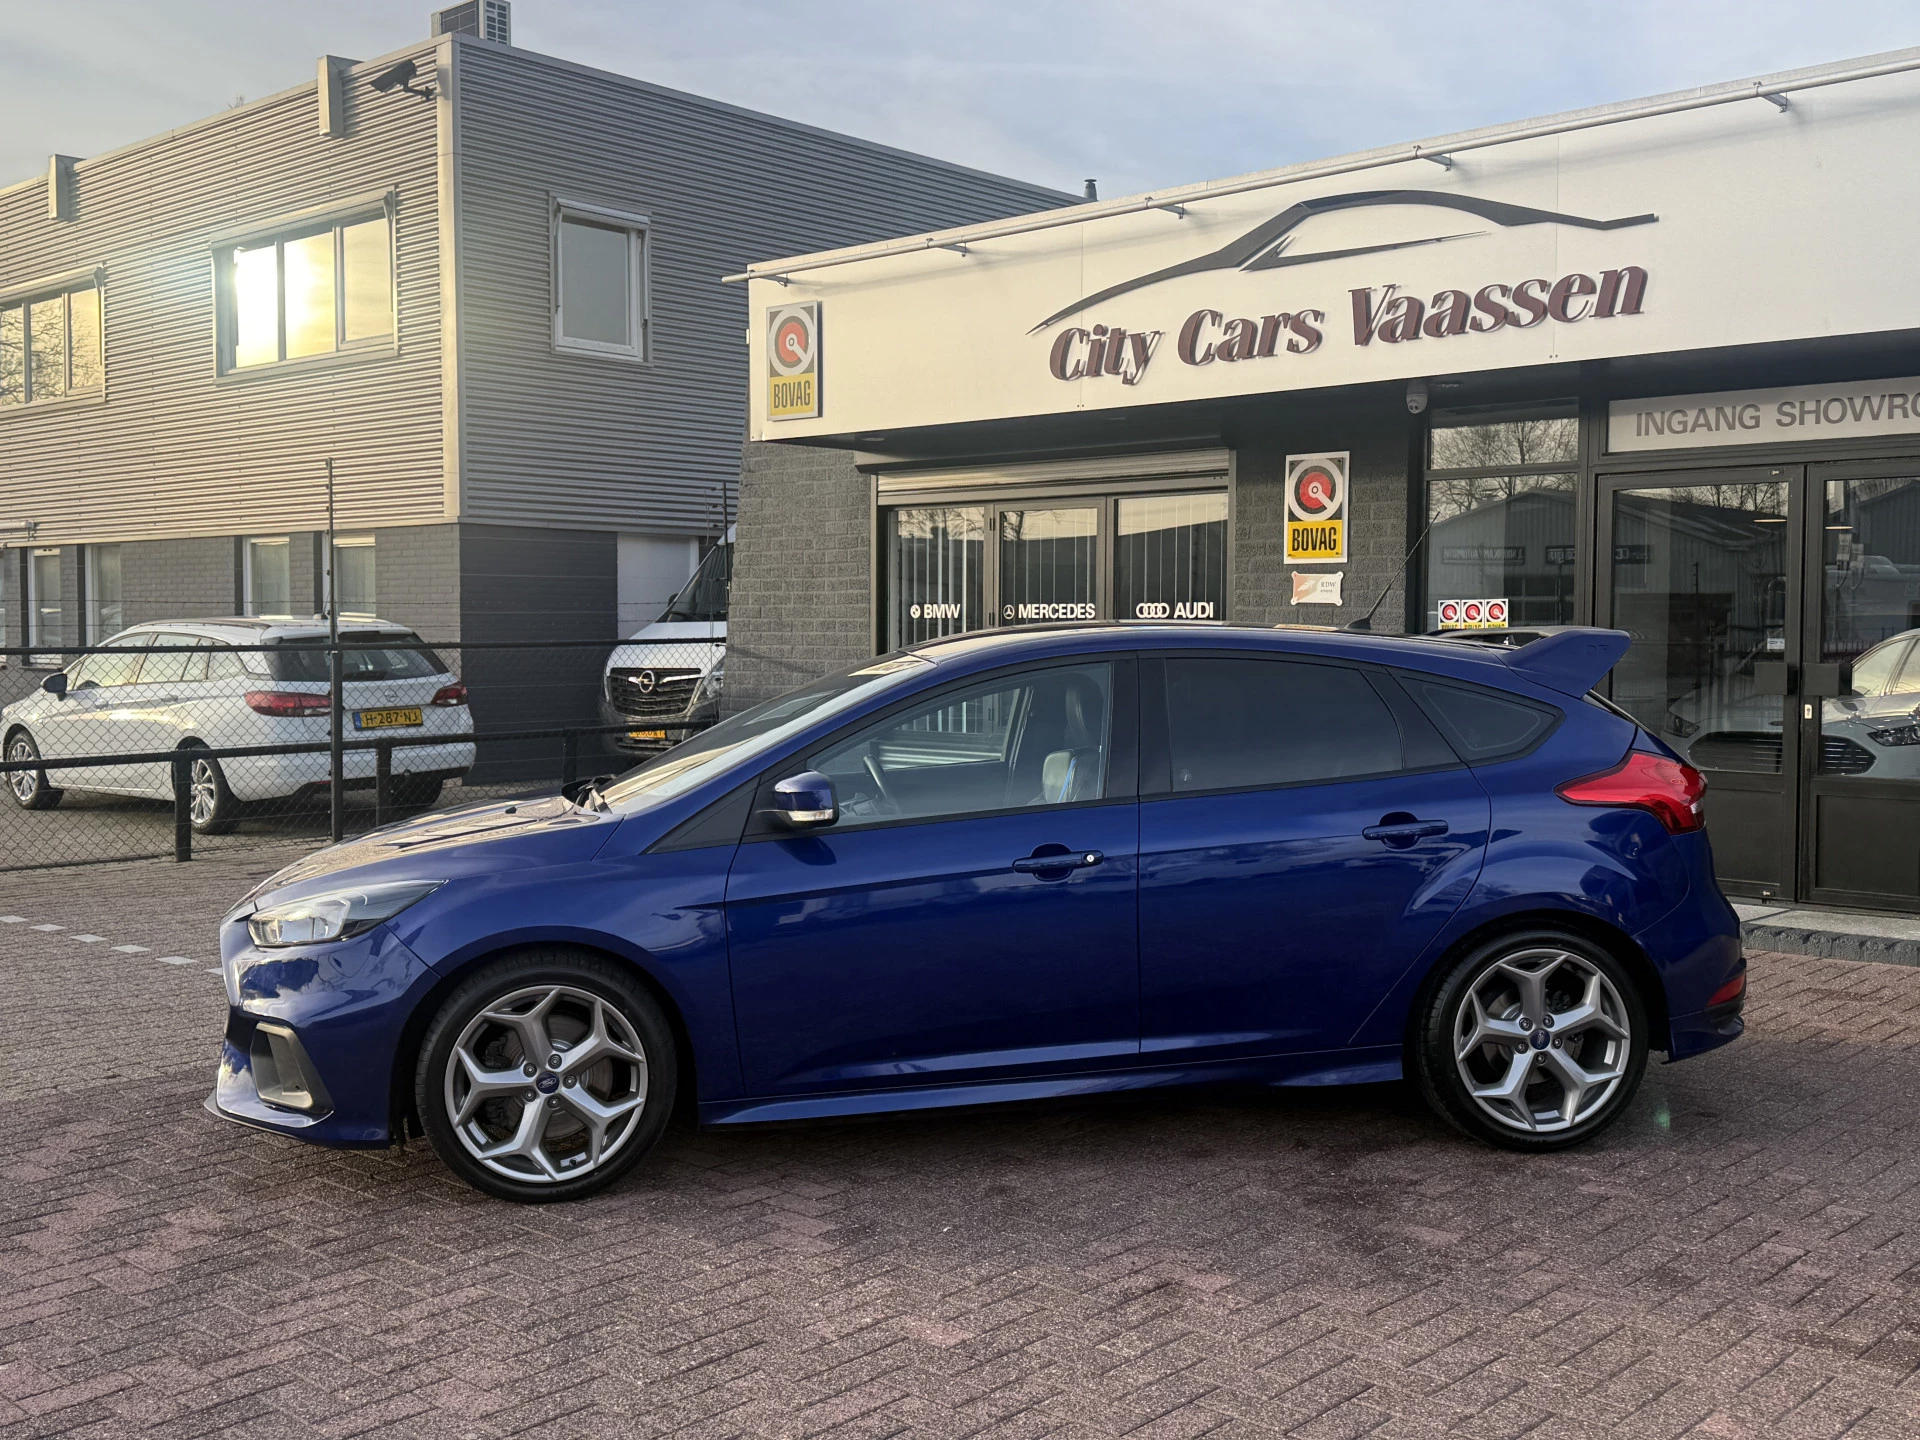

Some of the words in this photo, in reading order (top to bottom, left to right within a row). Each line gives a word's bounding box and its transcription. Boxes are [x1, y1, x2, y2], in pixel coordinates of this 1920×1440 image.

[1049, 324, 1161, 386] City
[1177, 307, 1322, 366] Cars
[1348, 264, 1648, 347] Vaassen
[774, 380, 811, 408] BOVAG
[1636, 404, 1761, 437] INGANG
[1292, 527, 1337, 551] BOVAG
[923, 603, 961, 619] BMW
[1018, 603, 1096, 619] MERCEDES
[1173, 601, 1214, 619] AUDI
[364, 711, 418, 726] H-287-NJ
